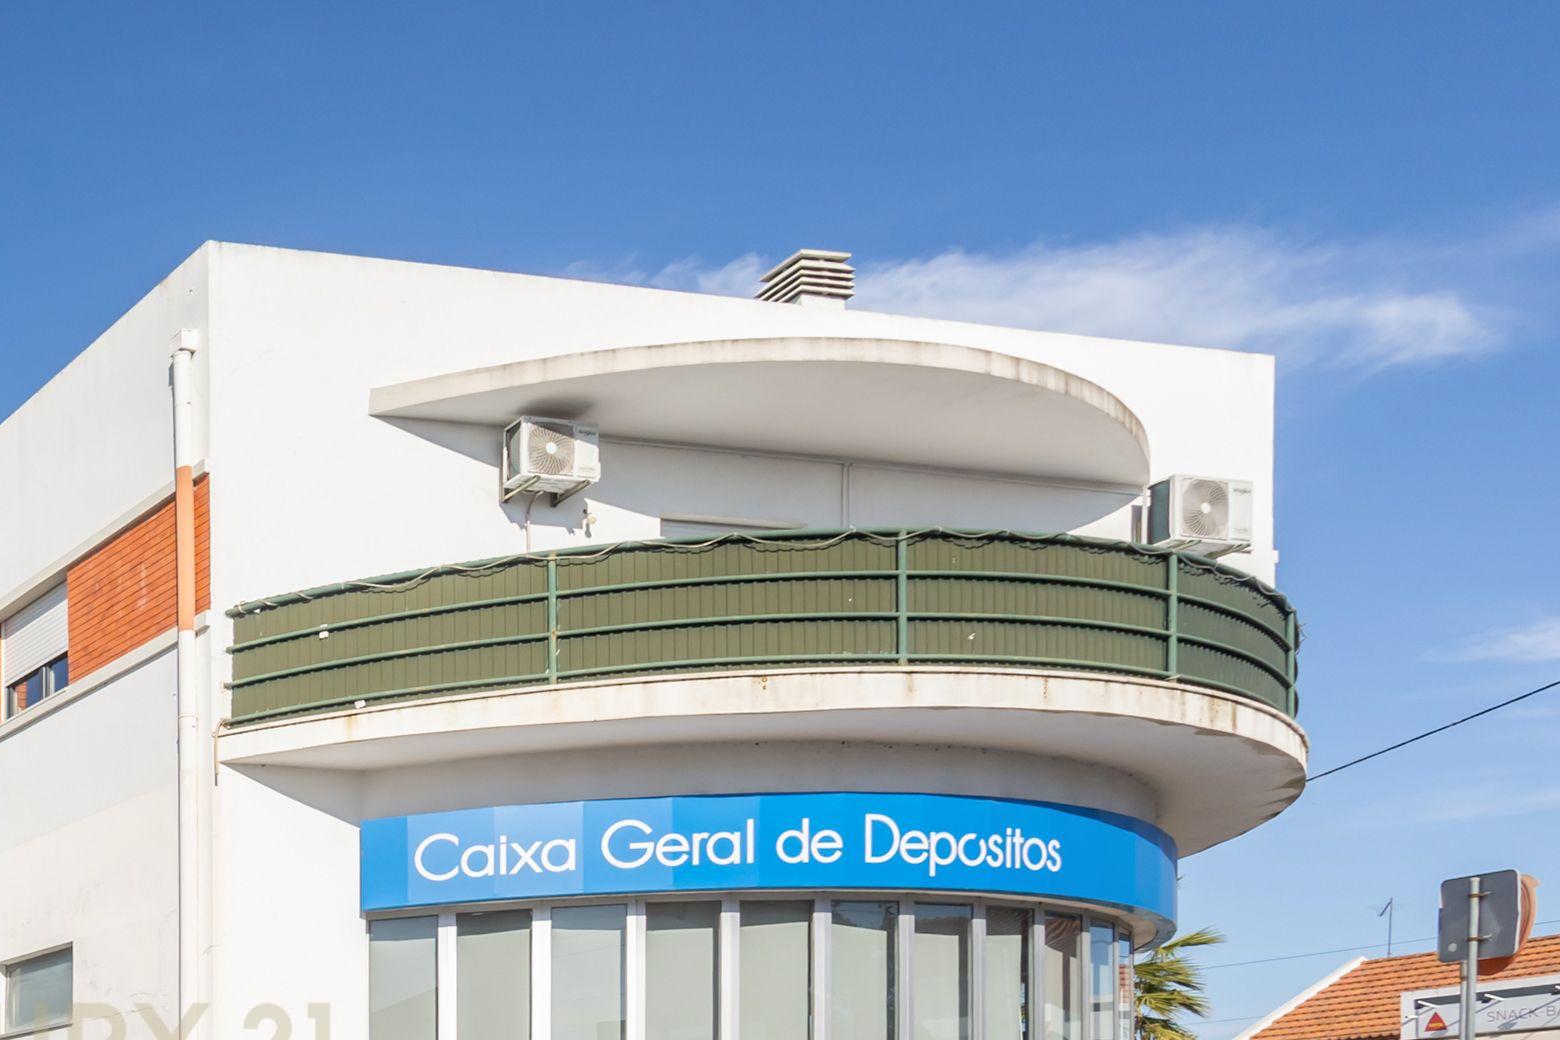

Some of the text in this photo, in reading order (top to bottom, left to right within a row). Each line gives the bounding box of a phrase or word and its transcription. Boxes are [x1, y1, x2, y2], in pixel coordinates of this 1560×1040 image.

[413, 812, 1062, 882] Caixa Geral de Depositos
